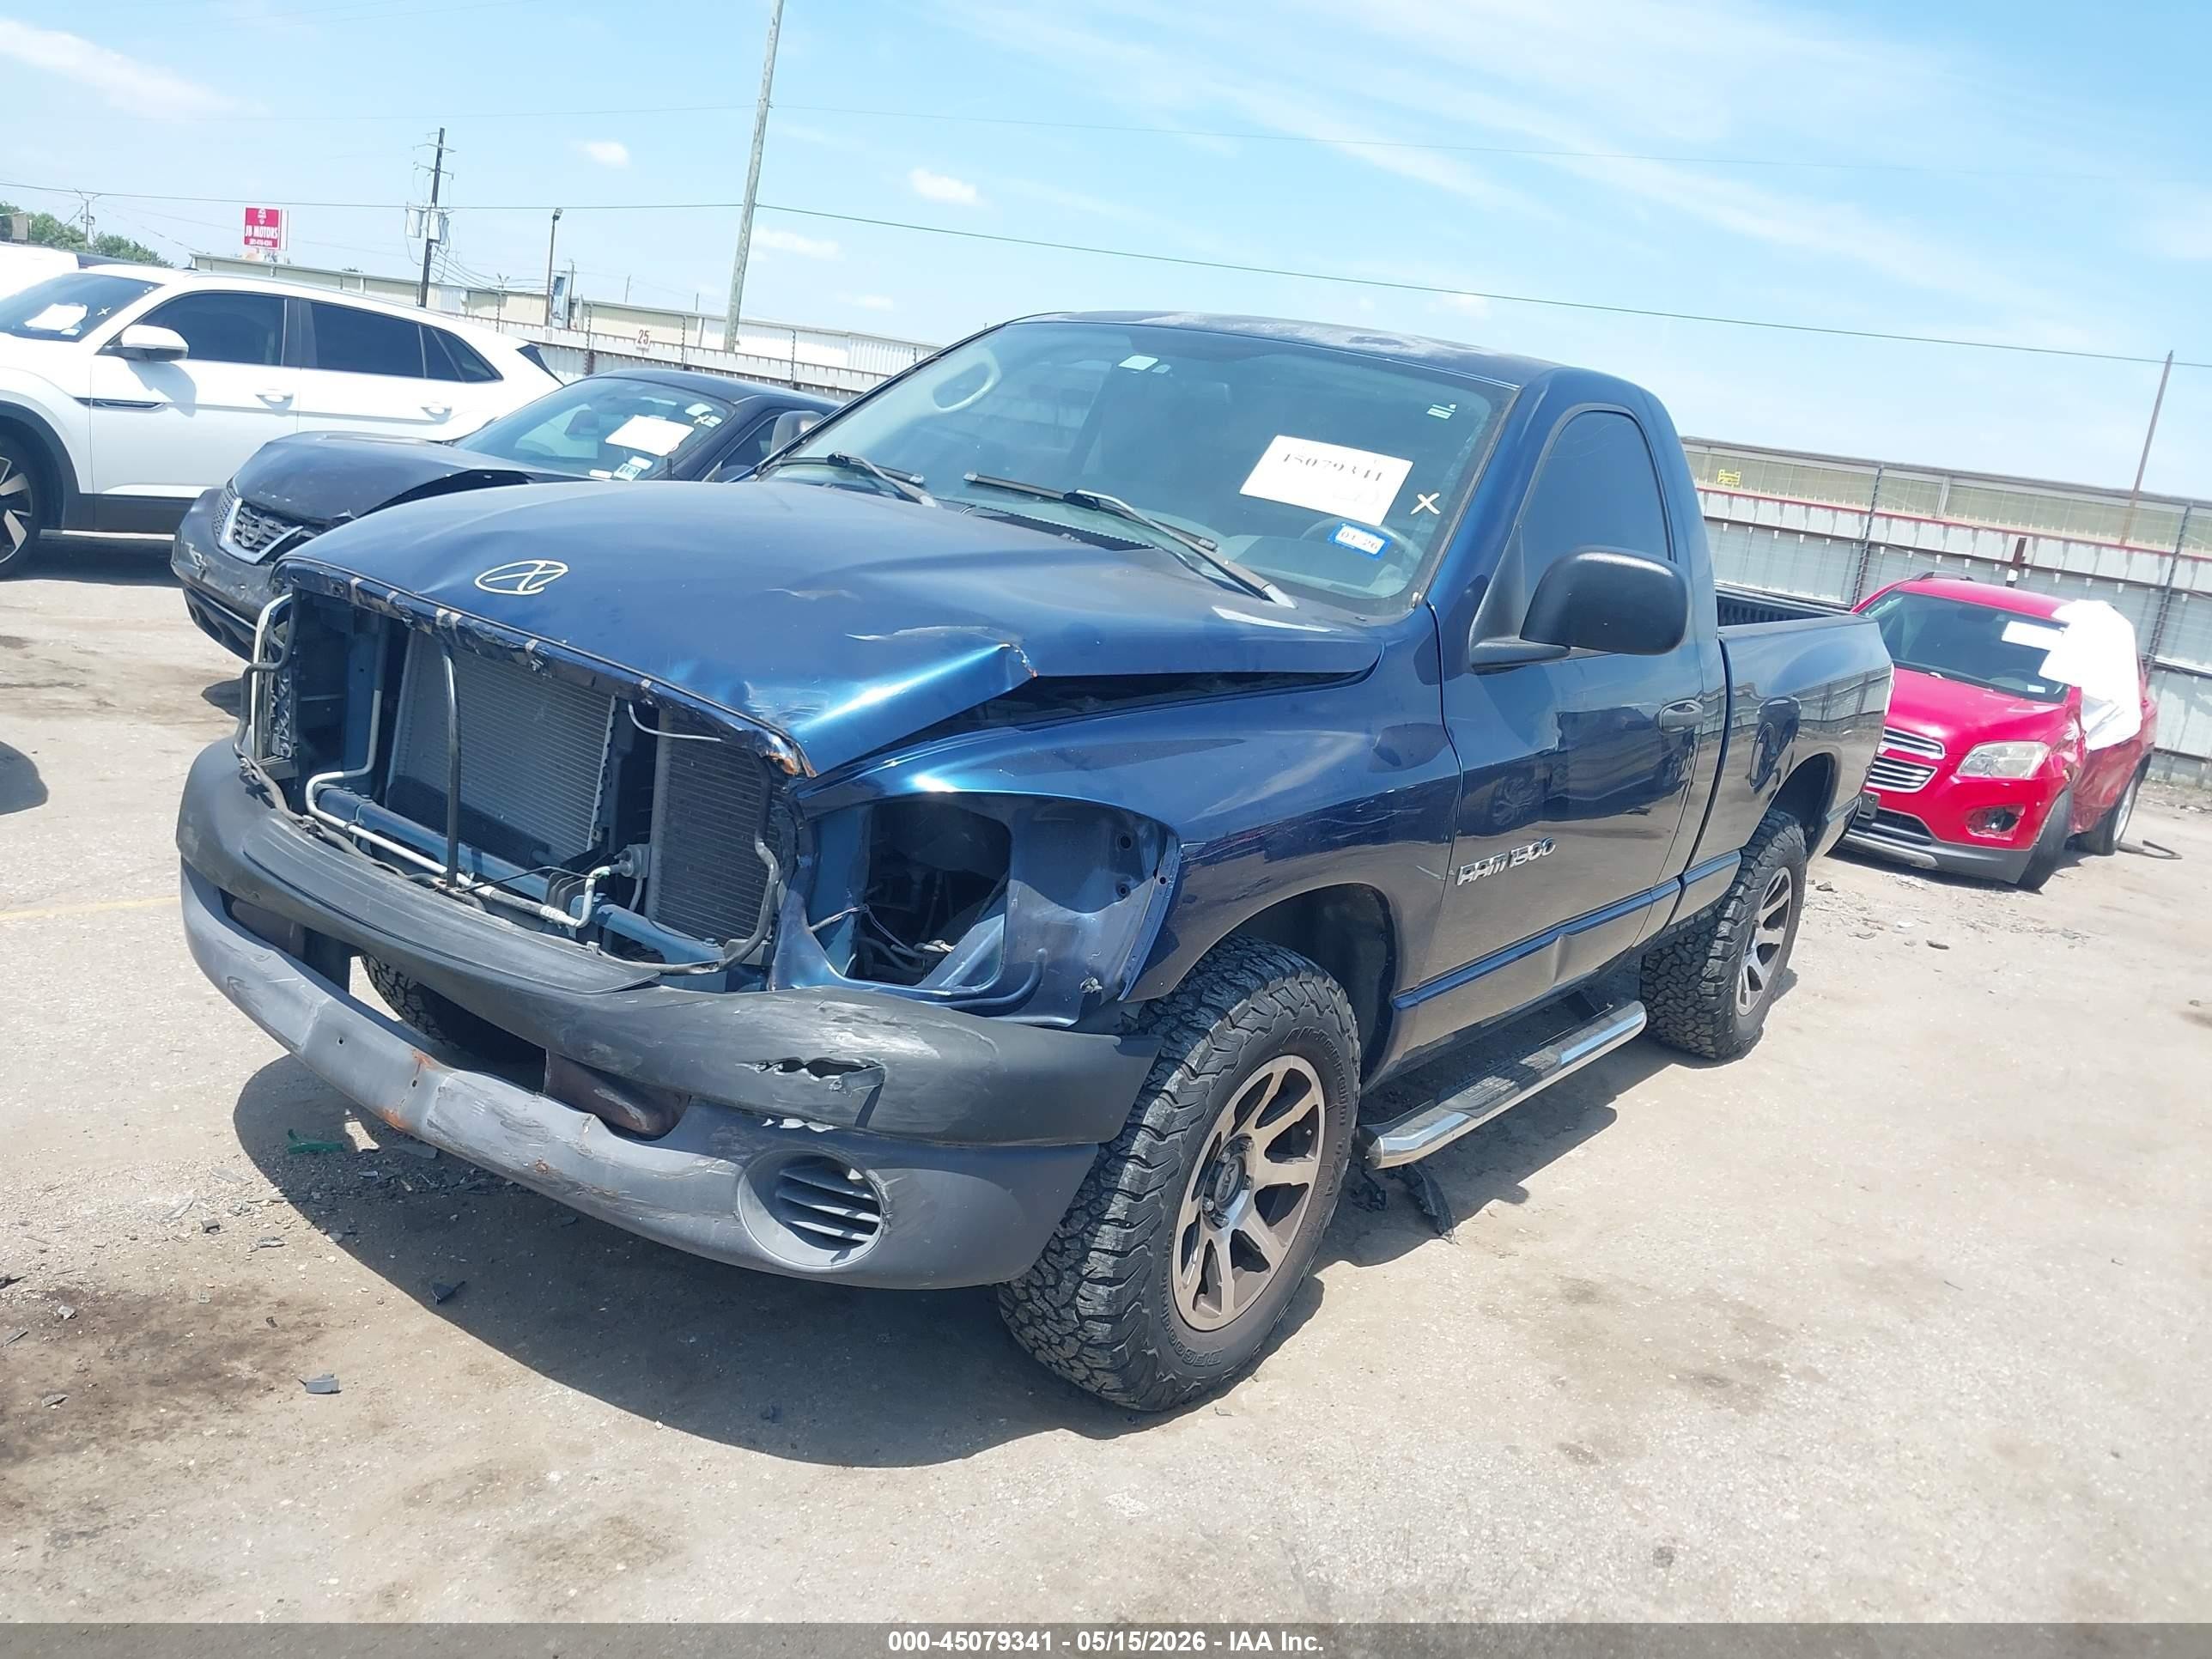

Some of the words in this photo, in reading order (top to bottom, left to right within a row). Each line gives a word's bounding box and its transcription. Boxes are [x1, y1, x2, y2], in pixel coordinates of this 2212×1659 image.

[252, 225, 279, 240] MOTORS
[637, 329, 651, 344] 25
[1455, 853, 1508, 886] RAM
[1508, 837, 1556, 868] 1500
